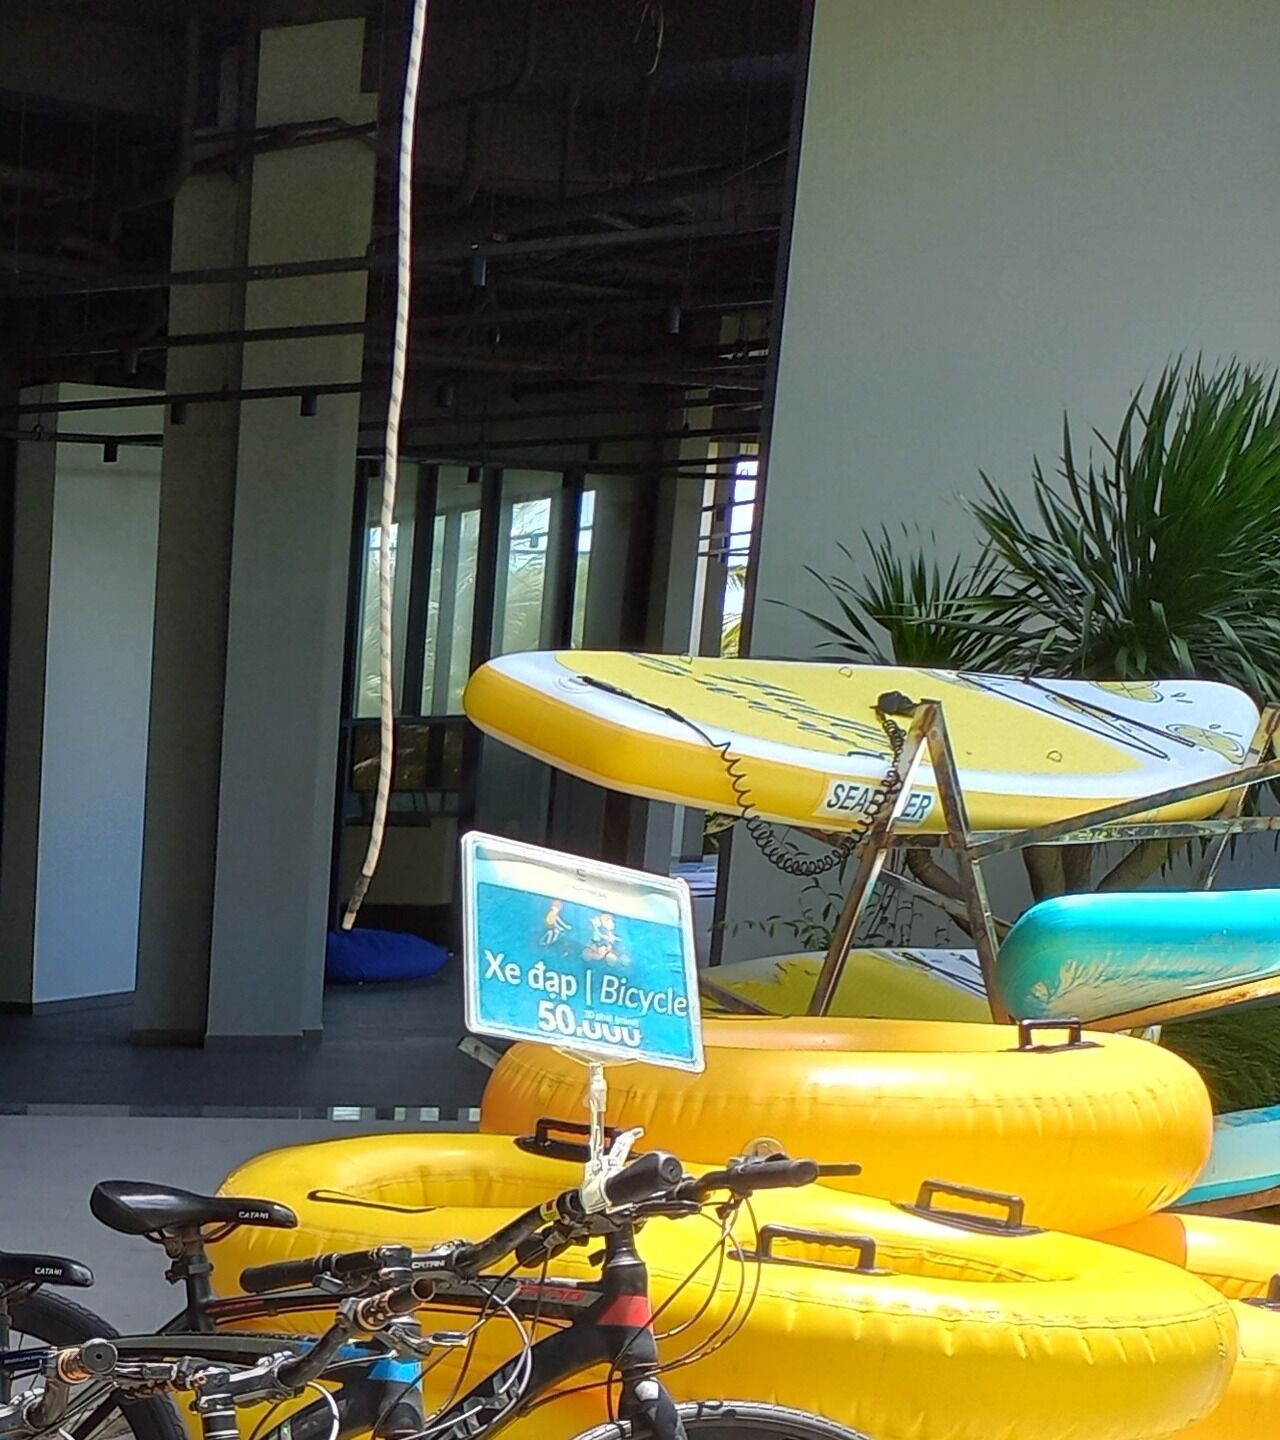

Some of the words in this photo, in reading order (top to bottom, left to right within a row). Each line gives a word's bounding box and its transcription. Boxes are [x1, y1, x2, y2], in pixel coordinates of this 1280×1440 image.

[483, 949, 522, 985] Xe
[527, 960, 578, 1001] đạp
[600, 974, 689, 1018] Bicycle
